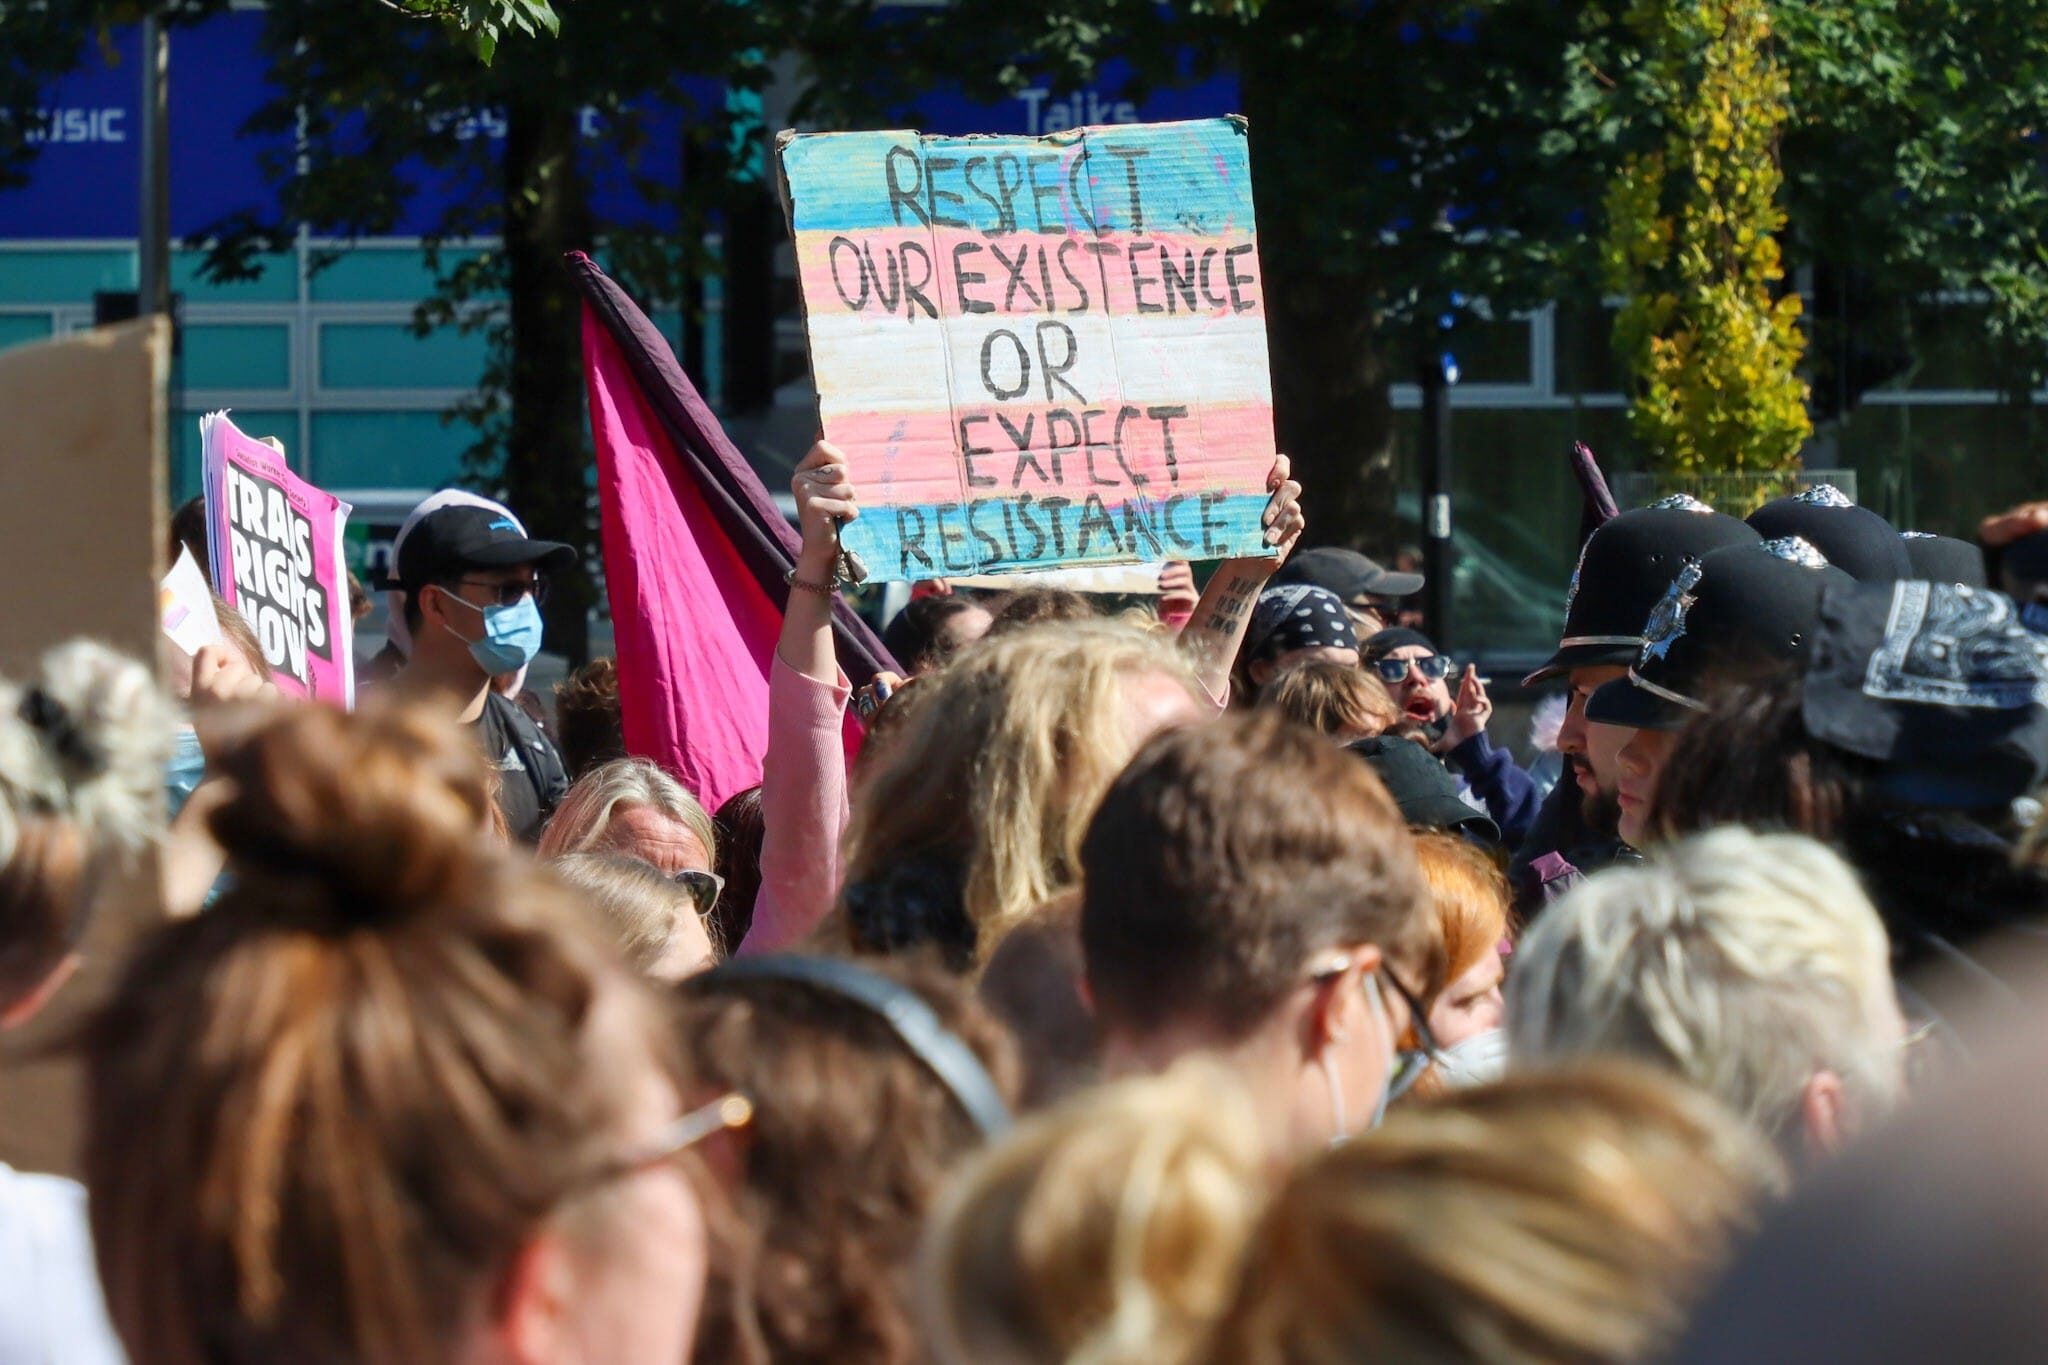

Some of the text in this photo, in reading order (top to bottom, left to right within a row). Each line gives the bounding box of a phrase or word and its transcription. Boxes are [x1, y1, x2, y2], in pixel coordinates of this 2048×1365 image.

[22, 108, 126, 142] USIC
[1017, 88, 1138, 136] Talks
[885, 145, 1149, 238] RESPECT
[829, 236, 1257, 323] OUR EXISTENCE
[979, 320, 1087, 405] OR
[959, 405, 1187, 489] EXPECT
[899, 492, 1230, 573] RESISTANCE
